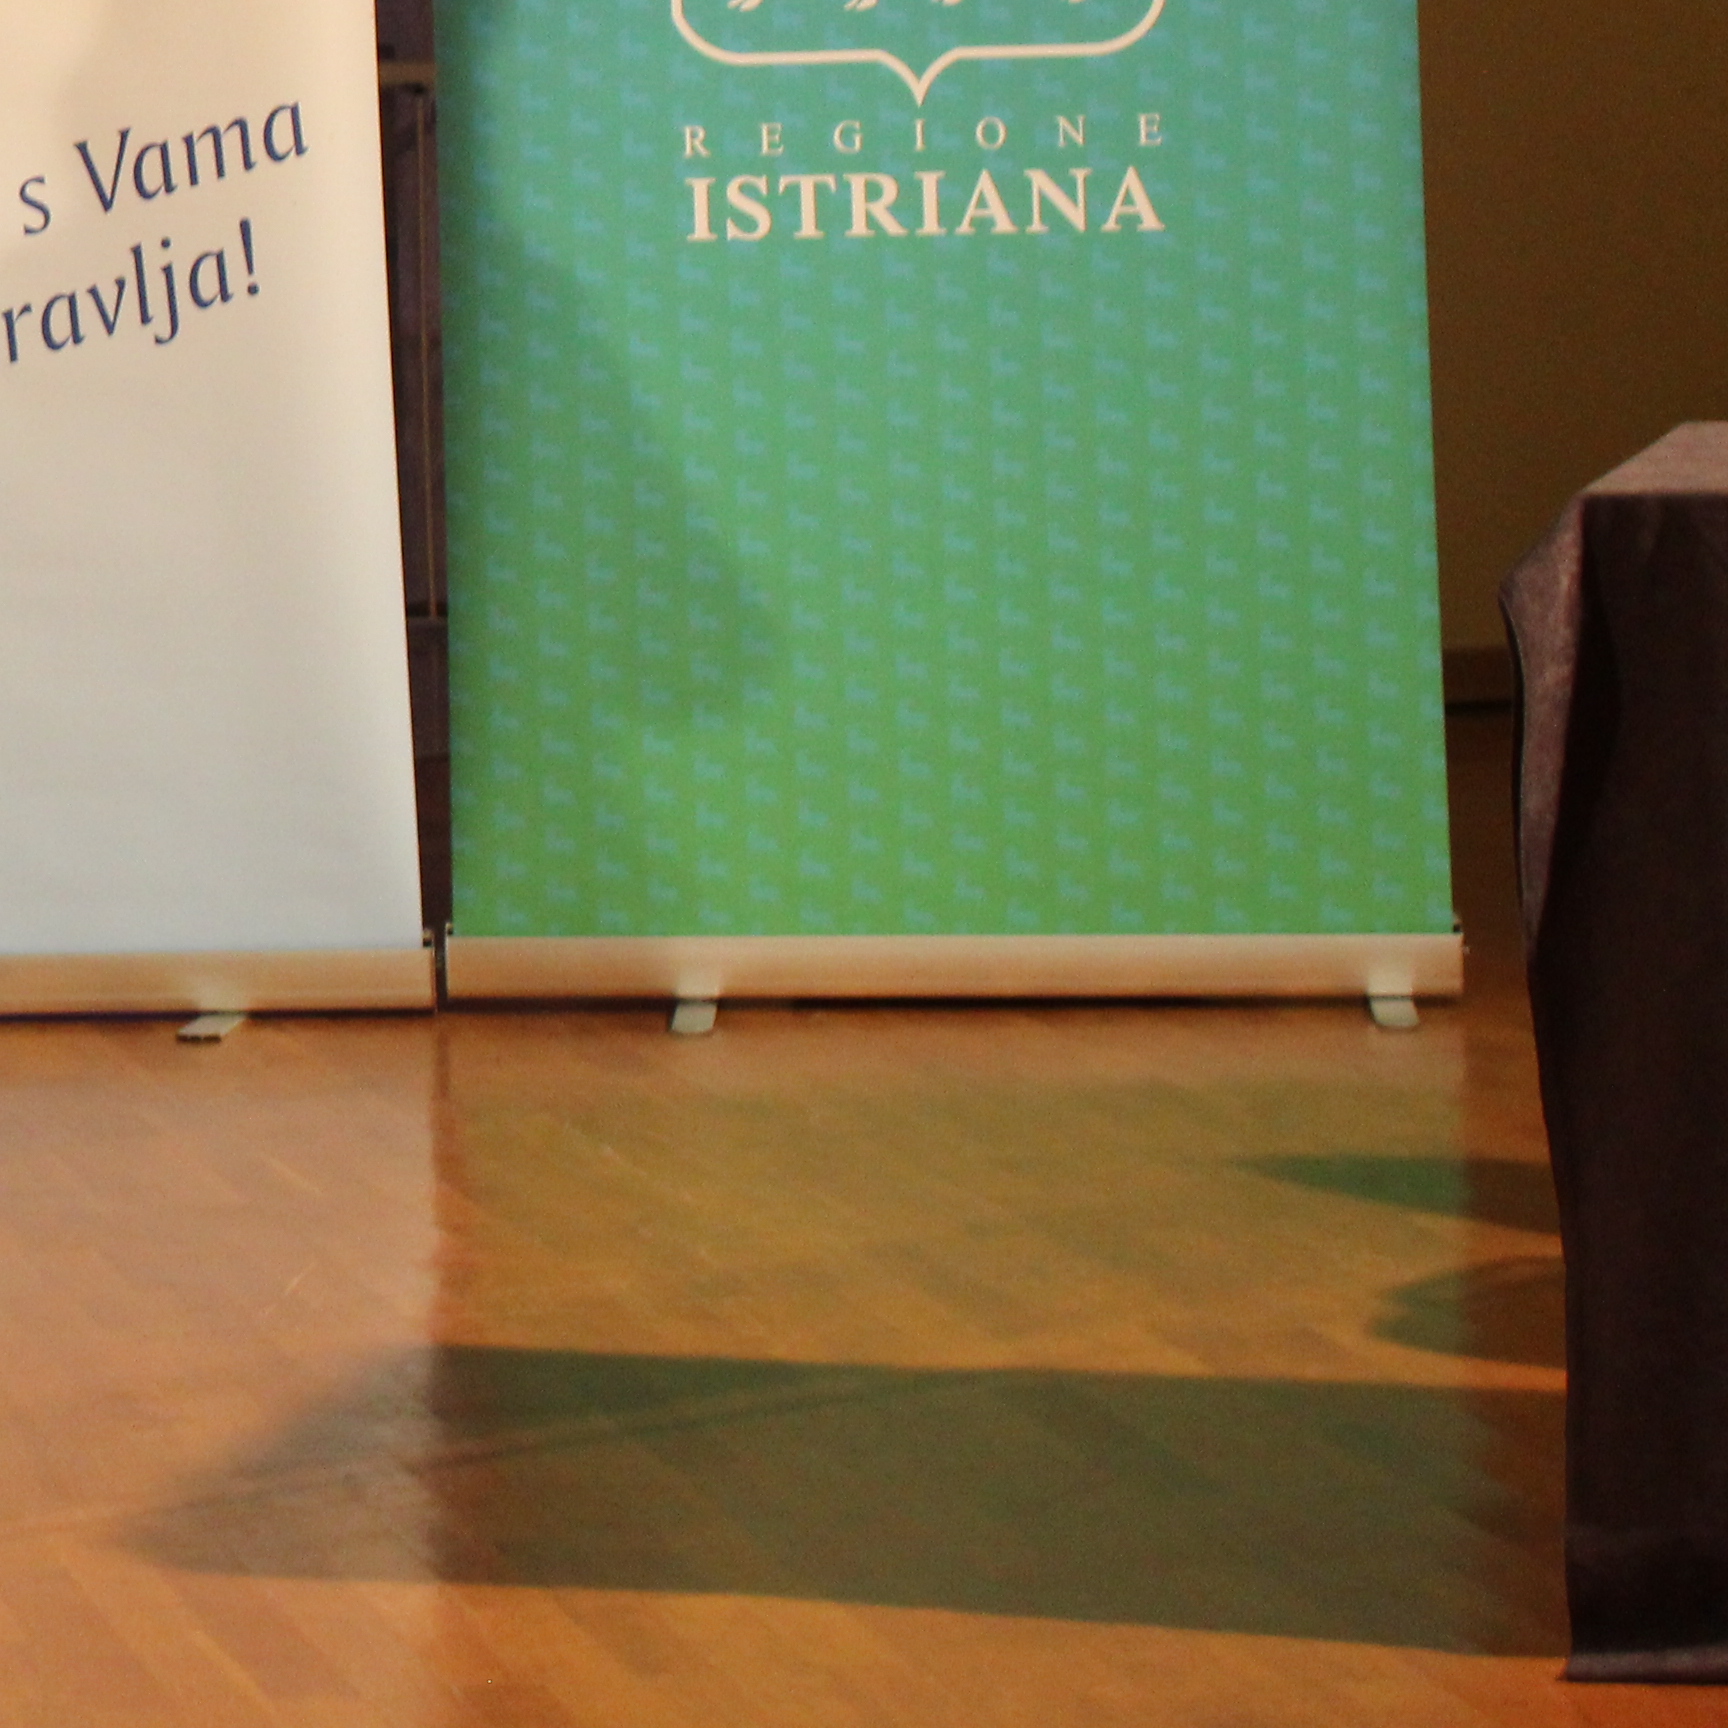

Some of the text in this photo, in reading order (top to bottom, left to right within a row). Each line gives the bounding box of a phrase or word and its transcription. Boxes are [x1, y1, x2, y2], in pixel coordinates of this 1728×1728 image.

[18, 175, 51, 235] s
[73, 100, 308, 214] Vama
[684, 113, 1162, 158] REGIONE
[685, 165, 1165, 241] ISTRIANA
